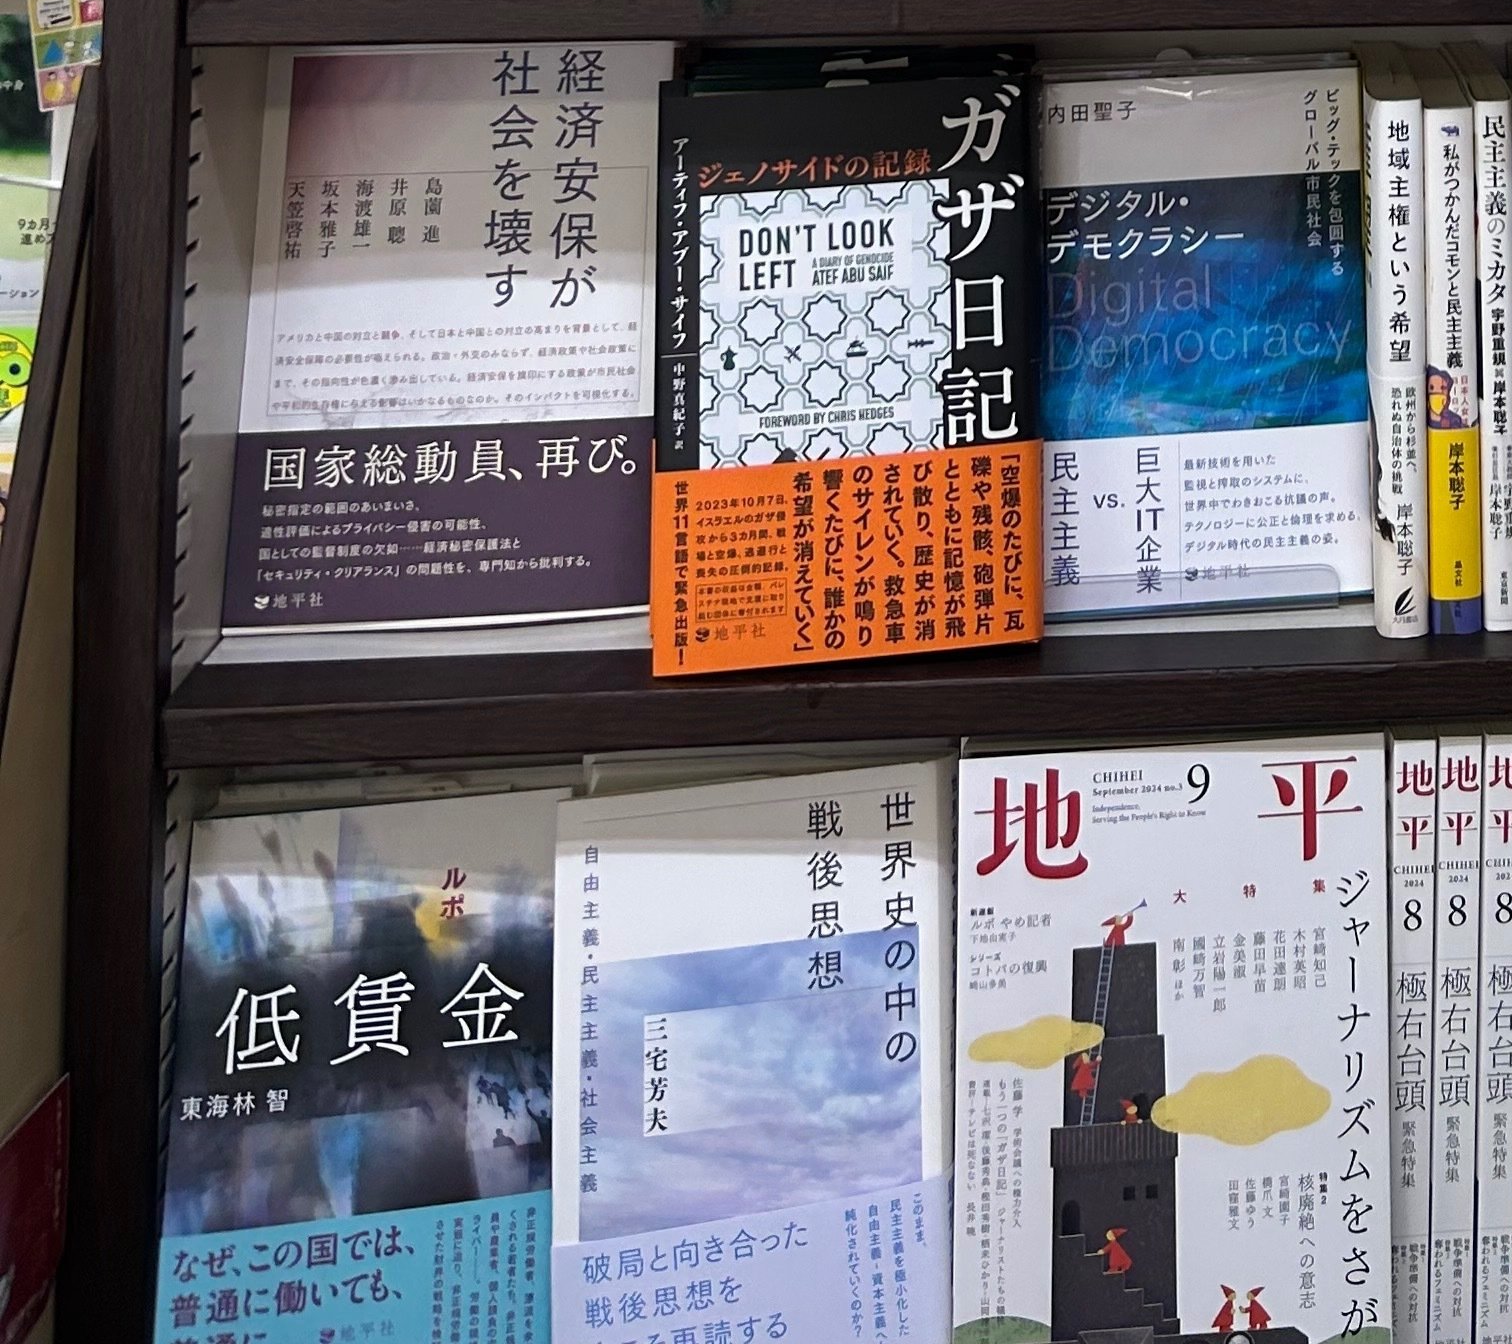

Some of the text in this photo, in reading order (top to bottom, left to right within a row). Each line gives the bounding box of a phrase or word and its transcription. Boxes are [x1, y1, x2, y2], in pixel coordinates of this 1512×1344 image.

[1046, 100, 1138, 125] 内田聖子
[484, 49, 541, 308] 社会を壊す
[549, 47, 606, 310] 経済安保が
[697, 147, 932, 190] ジェノサイドの記録
[827, 218, 894, 251] LOOK
[1481, 114, 1508, 304] 民主主義のミカタ
[938, 84, 1025, 446] ガザ日記
[1046, 228, 1245, 265] デモクラシー
[1387, 120, 1413, 364] 地域主権という希望
[1442, 143, 1464, 370] 私がつかんだコモンと民主主義
[739, 259, 796, 291] LEFT
[1048, 266, 1214, 329] Digital
[1048, 315, 1353, 375] Democracy
[262, 436, 637, 492] 国家総動員、再び。
[1050, 450, 1081, 587] 民主主義
[438, 865, 468, 920] ルポ
[805, 799, 845, 991] 戦後思想
[880, 791, 919, 1064] 世界史の中の
[215, 960, 526, 1077] 低賃金
[1396, 970, 1428, 1113] 極右台頭
[179, 1091, 256, 1121] 東海林
[644, 1016, 669, 1134] 三宅芳夫
[172, 1226, 415, 1284] なぜ、この国では、
[582, 1221, 809, 1284] 破局と向き合った
[169, 1268, 404, 1330] 普通に働いても、
